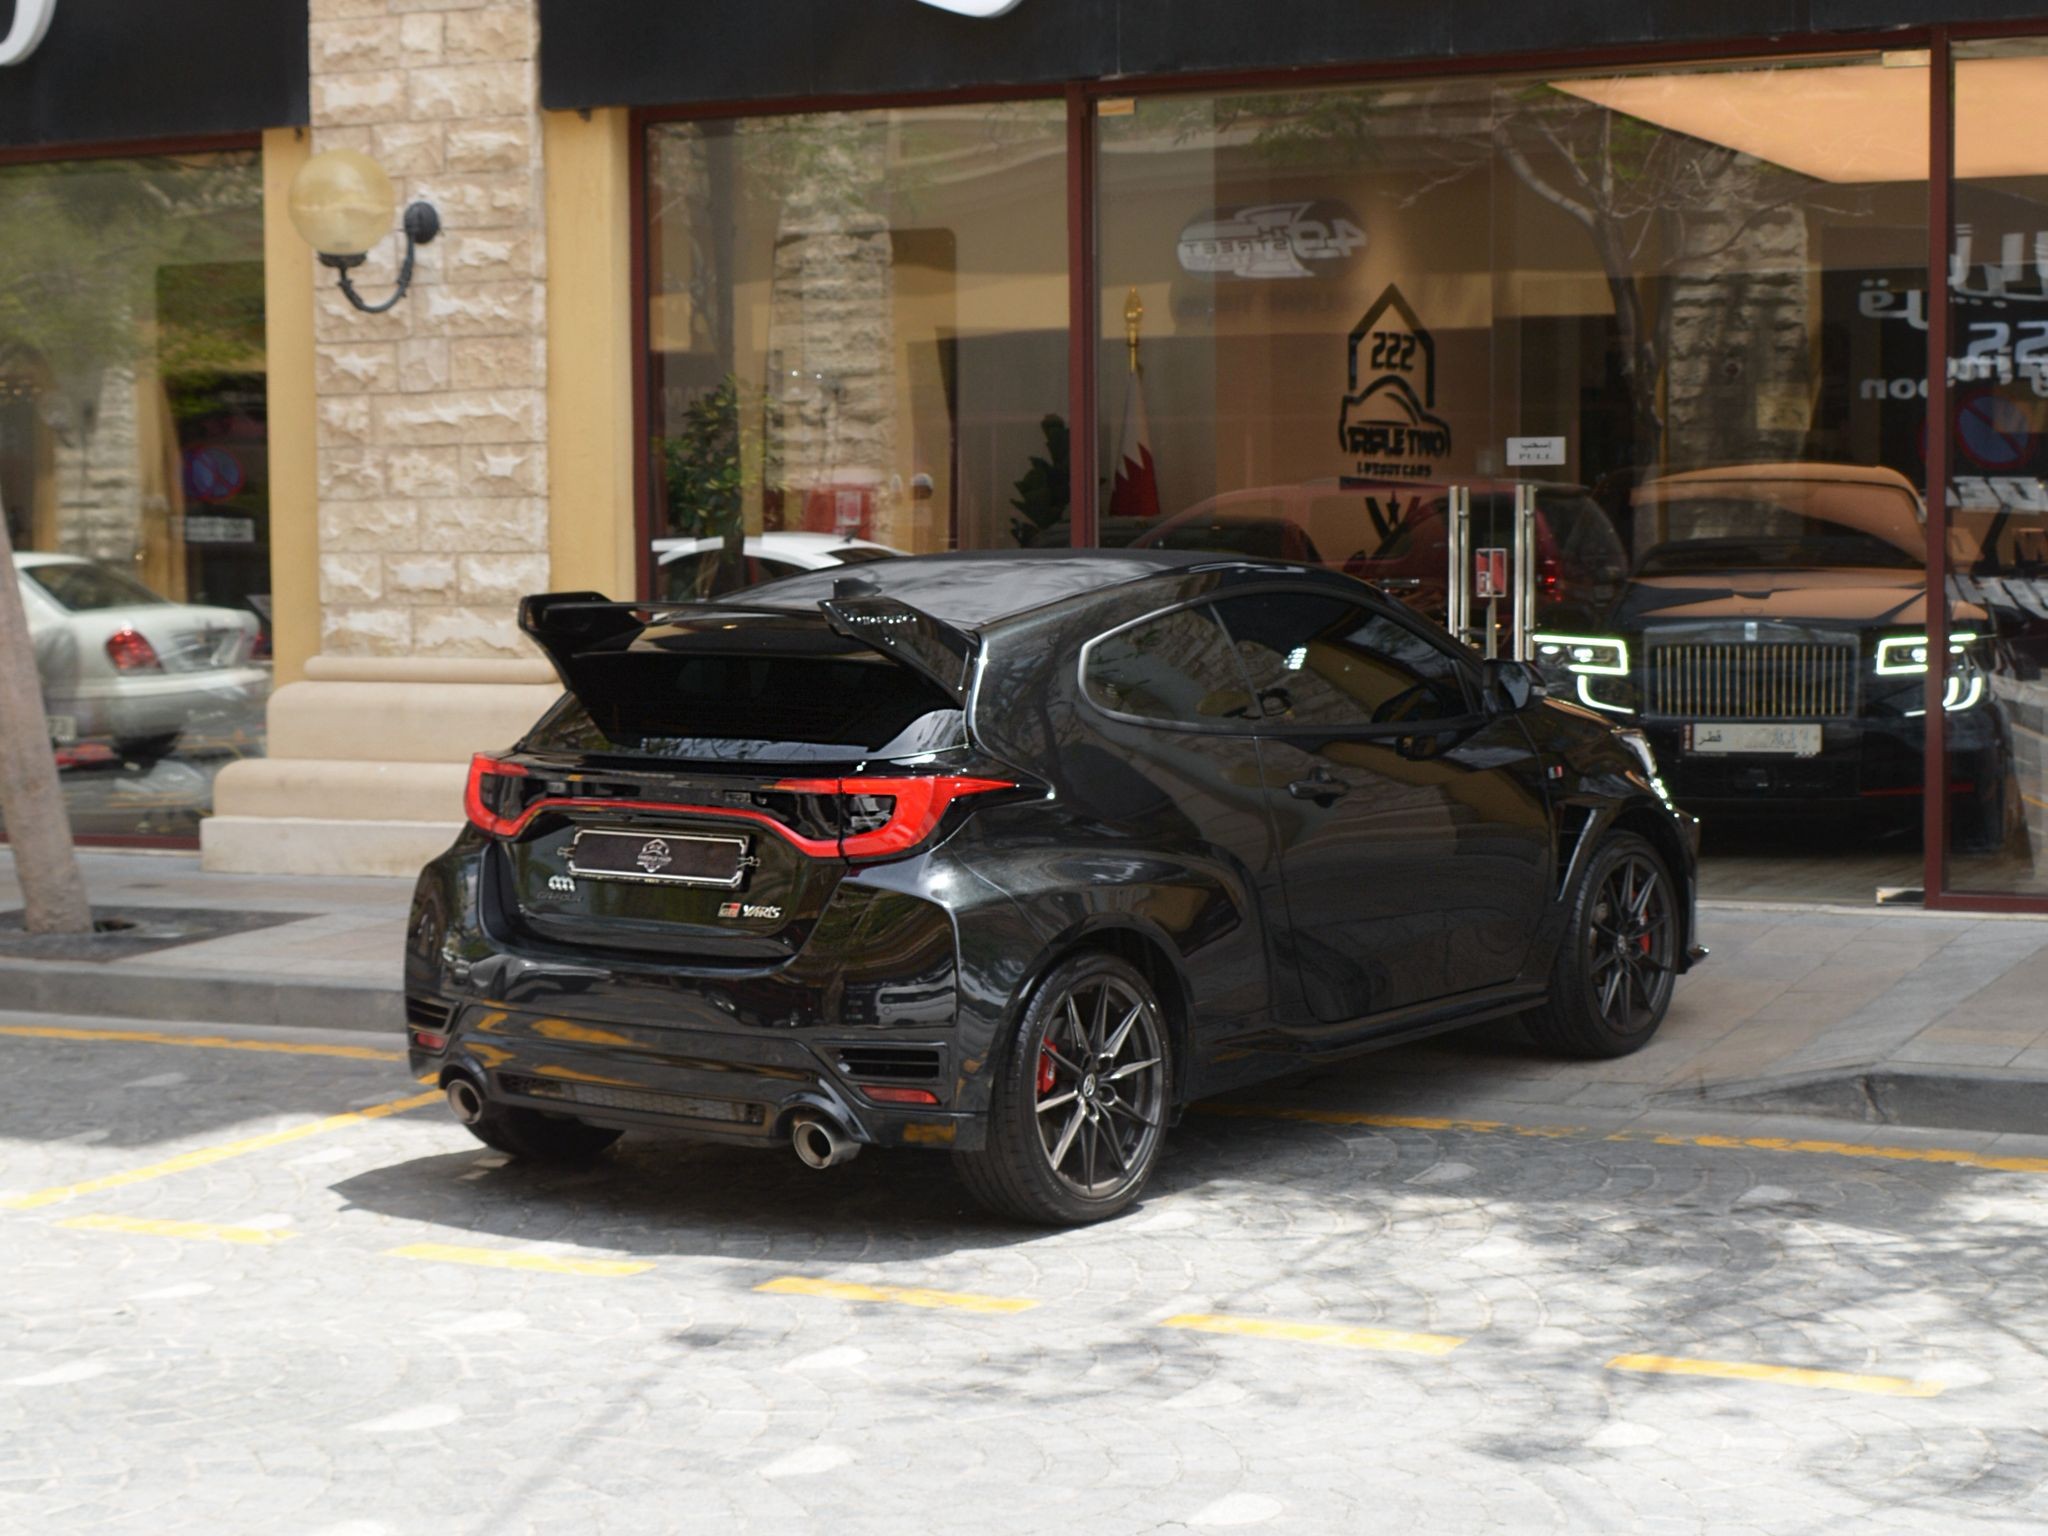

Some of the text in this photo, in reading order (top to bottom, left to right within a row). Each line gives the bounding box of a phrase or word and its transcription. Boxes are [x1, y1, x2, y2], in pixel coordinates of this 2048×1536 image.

[1370, 331, 1416, 371] 222
[1347, 425, 1446, 458] TRIPLE TWO
